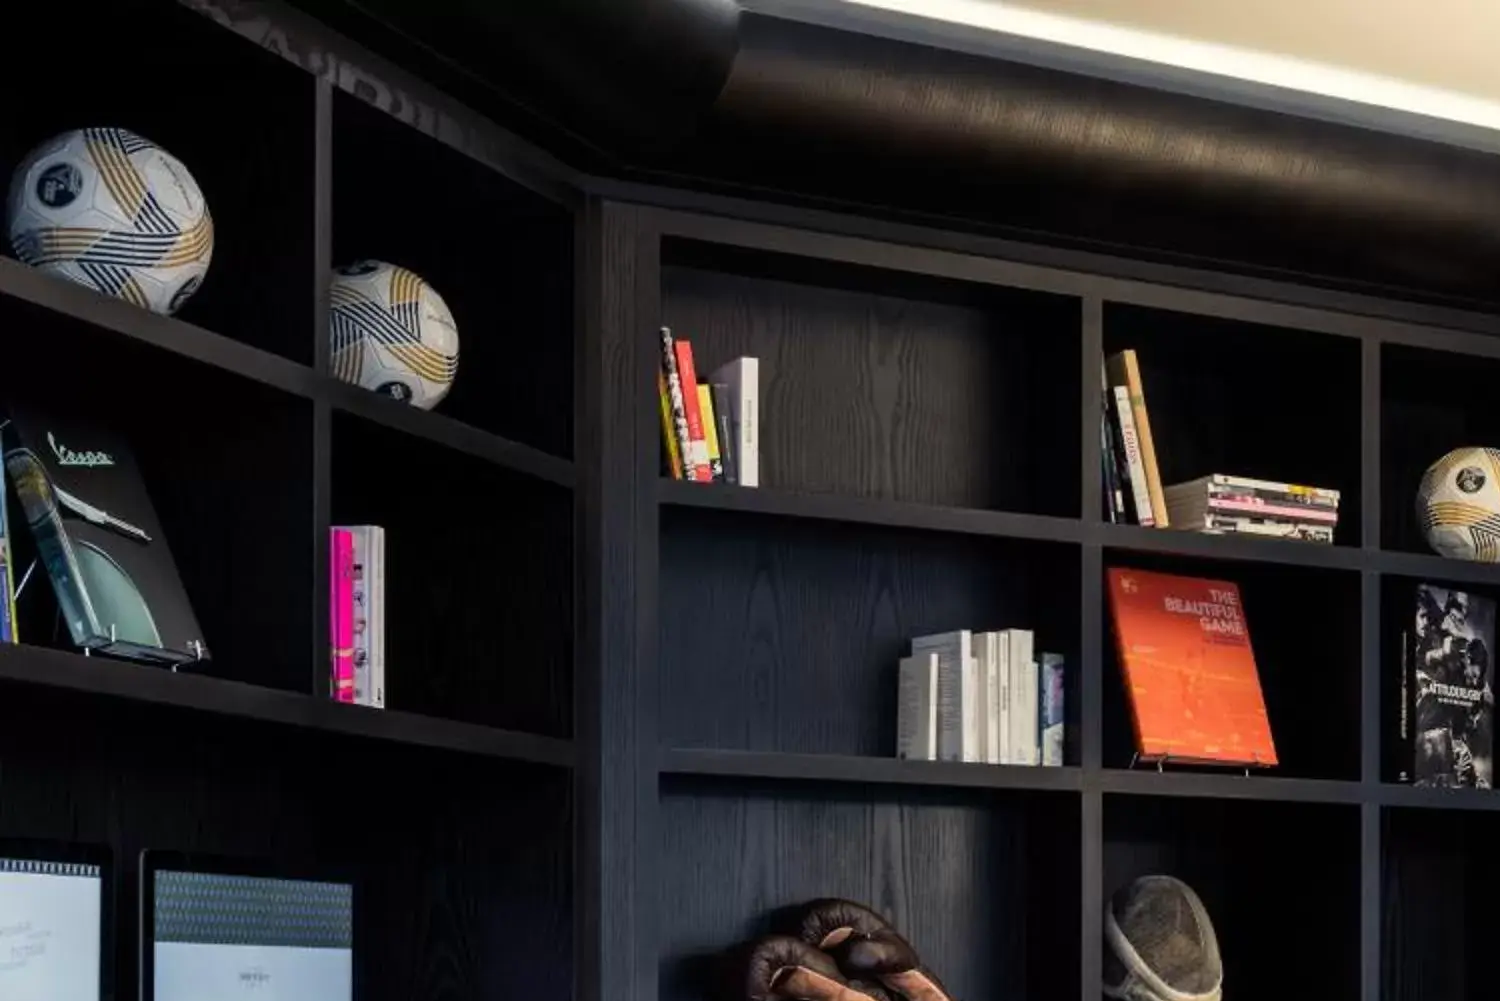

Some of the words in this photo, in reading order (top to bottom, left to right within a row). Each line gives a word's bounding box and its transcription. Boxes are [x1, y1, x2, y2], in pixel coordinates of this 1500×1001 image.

[47, 431, 115, 468] Vespa
[1208, 589, 1239, 605] THE
[1164, 597, 1241, 620] BEAUTIFUL
[1200, 616, 1244, 635] GAME
